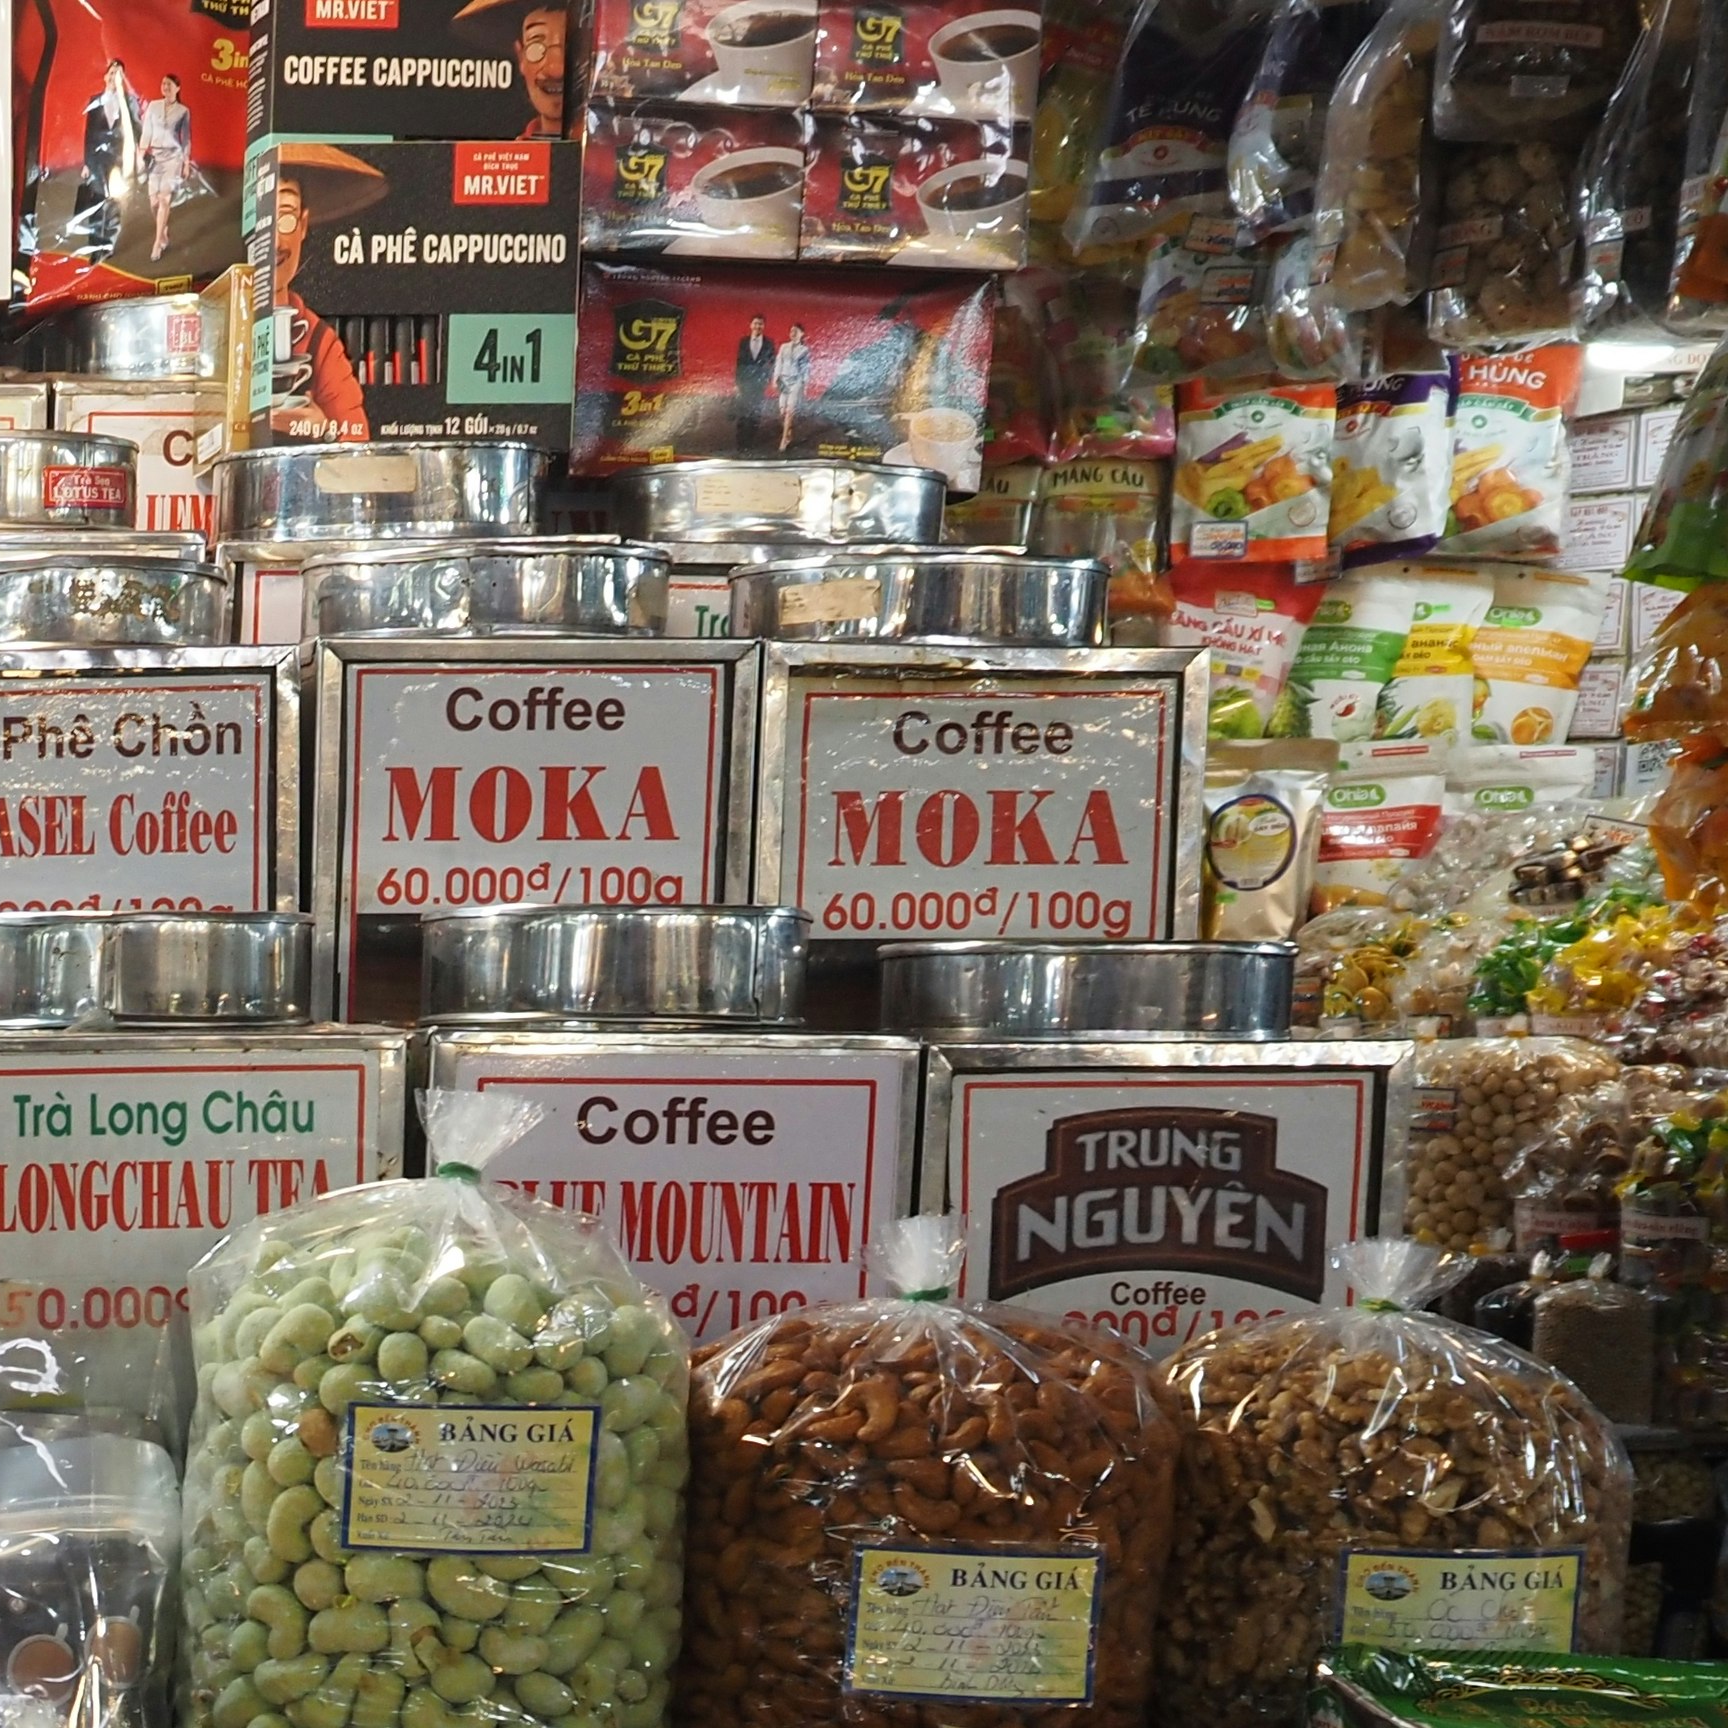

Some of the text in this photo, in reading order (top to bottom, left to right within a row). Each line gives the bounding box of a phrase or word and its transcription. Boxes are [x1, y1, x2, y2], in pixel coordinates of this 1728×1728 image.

[283, 56, 513, 90] COFFEE CAPPUCCINO
[464, 174, 538, 196] MR.VIET
[333, 227, 566, 264] CÀ PHÊ CAPPUCCINO
[445, 413, 488, 435] 12 GÓI
[101, 486, 122, 501] TEA
[2, 715, 97, 761] Phê
[113, 703, 243, 759] Chồn
[446, 686, 626, 736] Coffee
[892, 710, 1074, 756] Coffee
[108, 789, 238, 856] Coffee
[382, 763, 680, 844] MOKA
[827, 787, 1130, 868] MOKA
[12, 1089, 315, 1147] Trà Long Châu
[576, 1094, 776, 1147] Coffee
[1075, 1129, 1242, 1174] TRUNG
[248, 1158, 331, 1216] TEA
[618, 1178, 857, 1268] MOUNTAIN
[1017, 1178, 1308, 1264] NGUYÊN
[444, 1417, 574, 1444] BẢNG GIÁ
[951, 1566, 1080, 1592] BẢNG GIÁ
